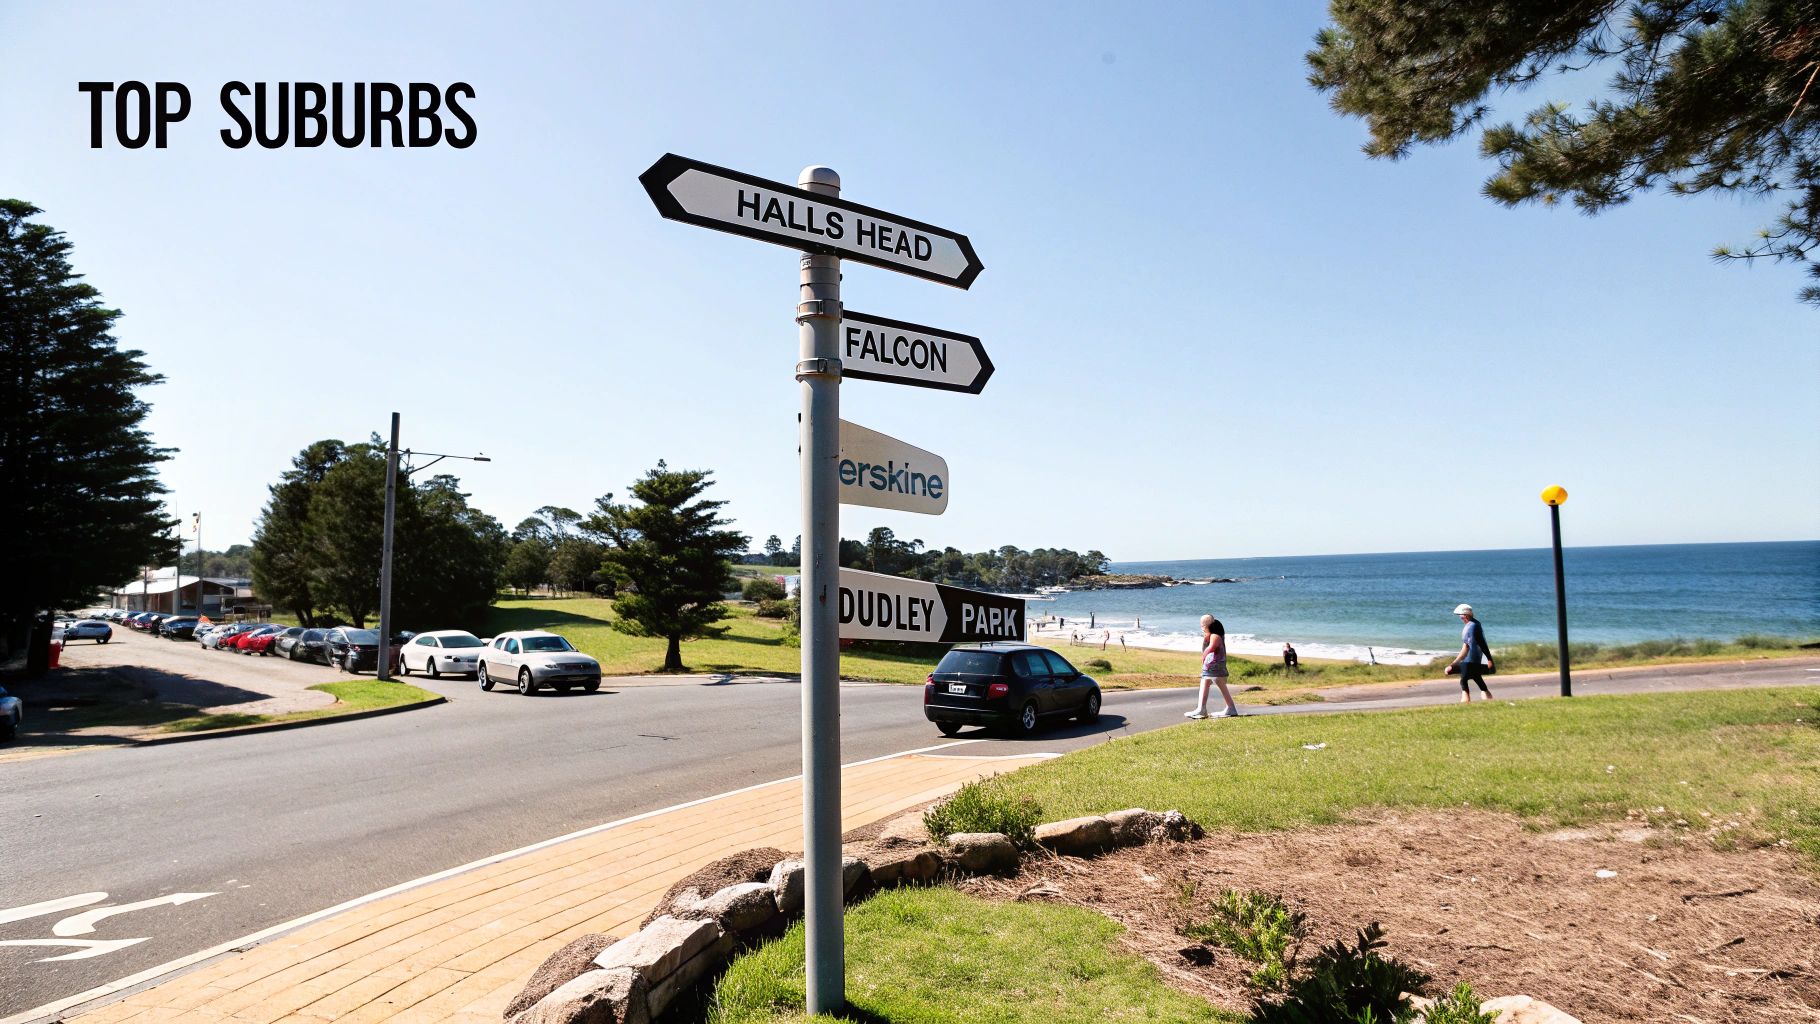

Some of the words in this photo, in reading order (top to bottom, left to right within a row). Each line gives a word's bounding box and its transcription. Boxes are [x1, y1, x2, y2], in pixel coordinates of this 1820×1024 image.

[737, 189, 844, 240] HALLS
[856, 218, 932, 262] HEAD
[846, 327, 948, 373] FALCON
[838, 459, 943, 499] erskine
[838, 587, 935, 633] DUDLEY
[961, 602, 1018, 637] PARK
